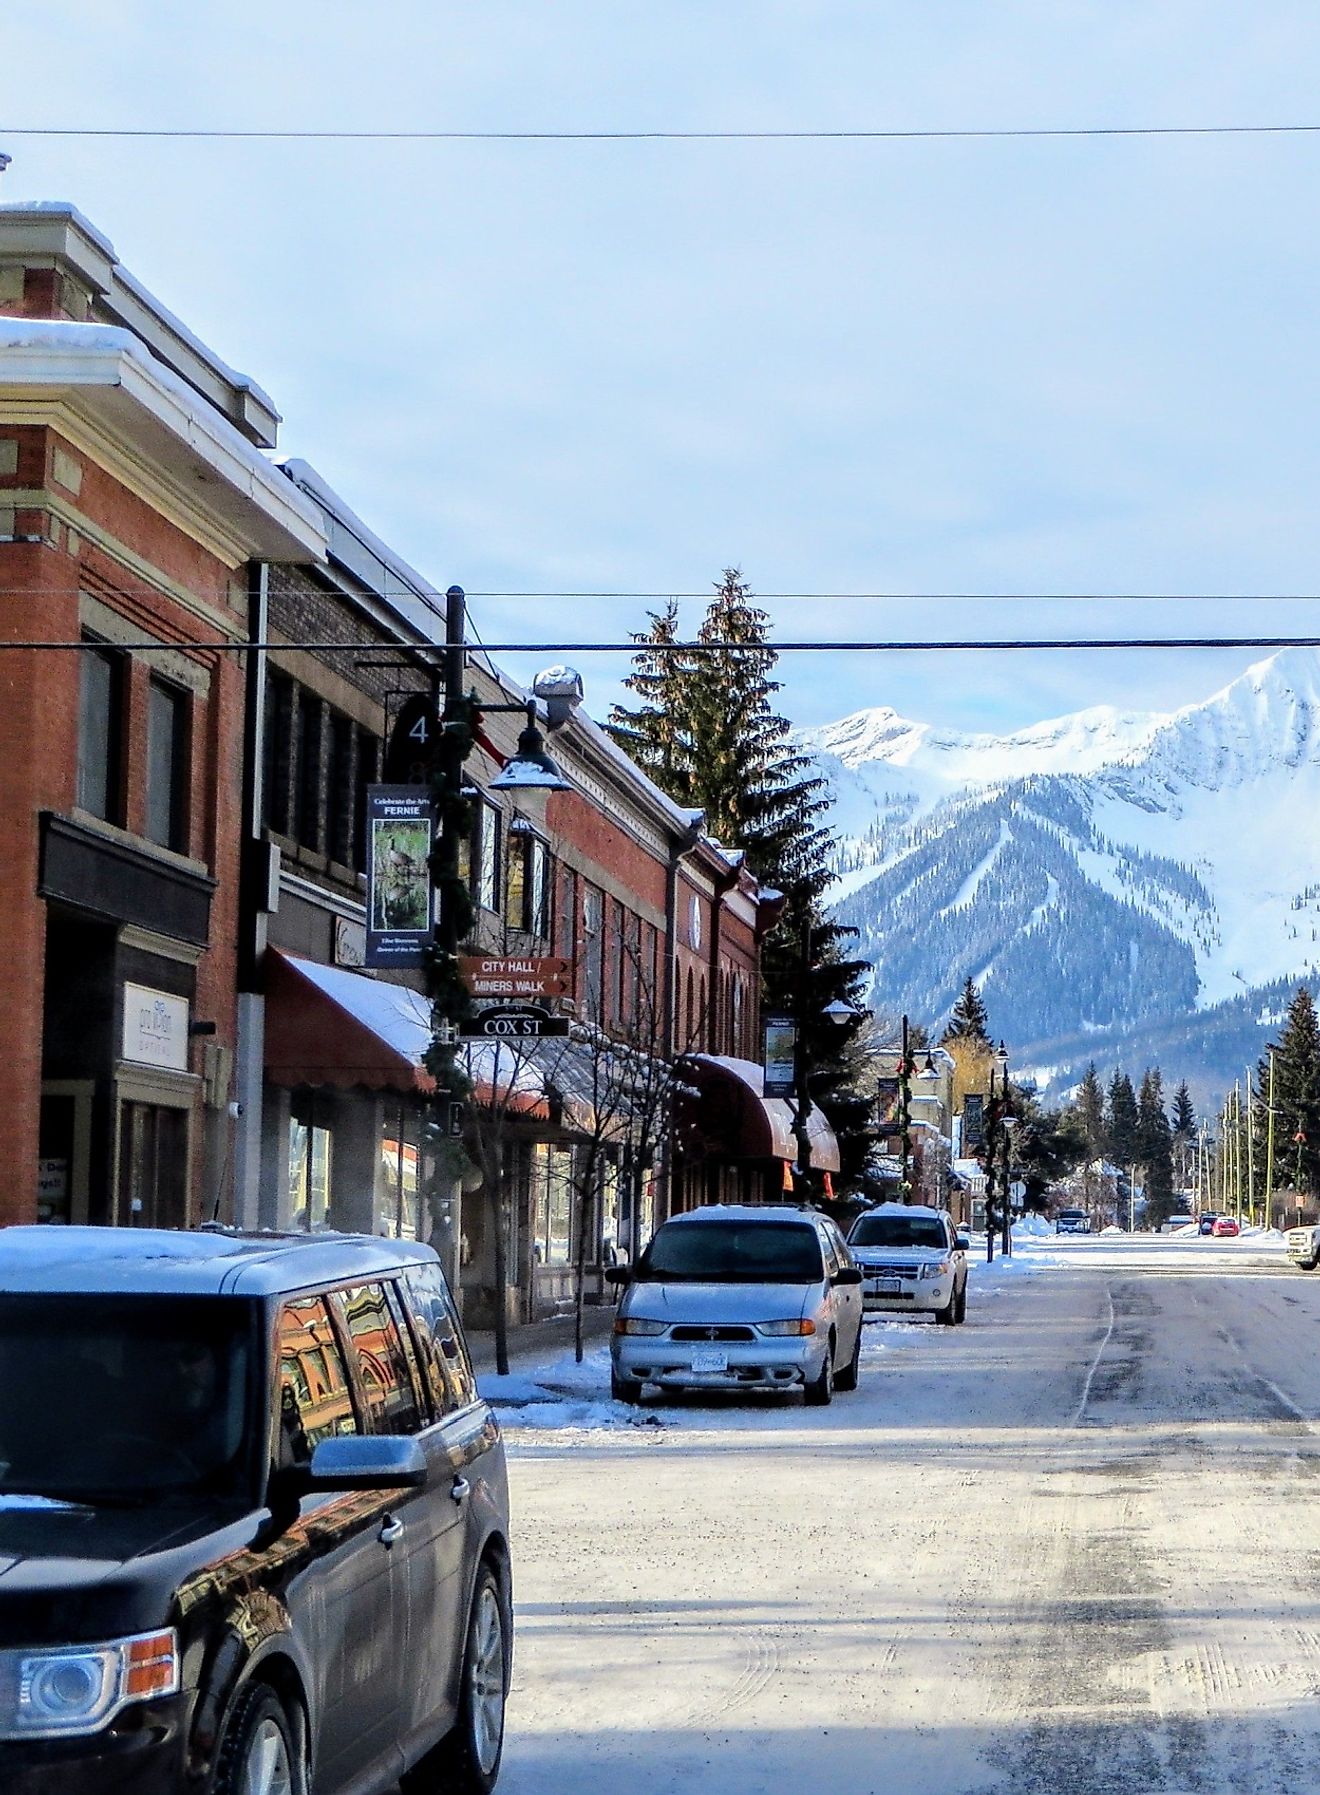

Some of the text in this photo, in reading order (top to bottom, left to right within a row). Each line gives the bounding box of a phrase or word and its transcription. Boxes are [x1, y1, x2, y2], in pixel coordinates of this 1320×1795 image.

[408, 715, 429, 744] 4
[384, 806, 421, 815] FERNIE
[481, 961, 506, 973] CITY
[508, 961, 535, 973] HALL
[474, 980, 545, 992] MINERS WALK
[484, 1020, 543, 1035] COX ST
